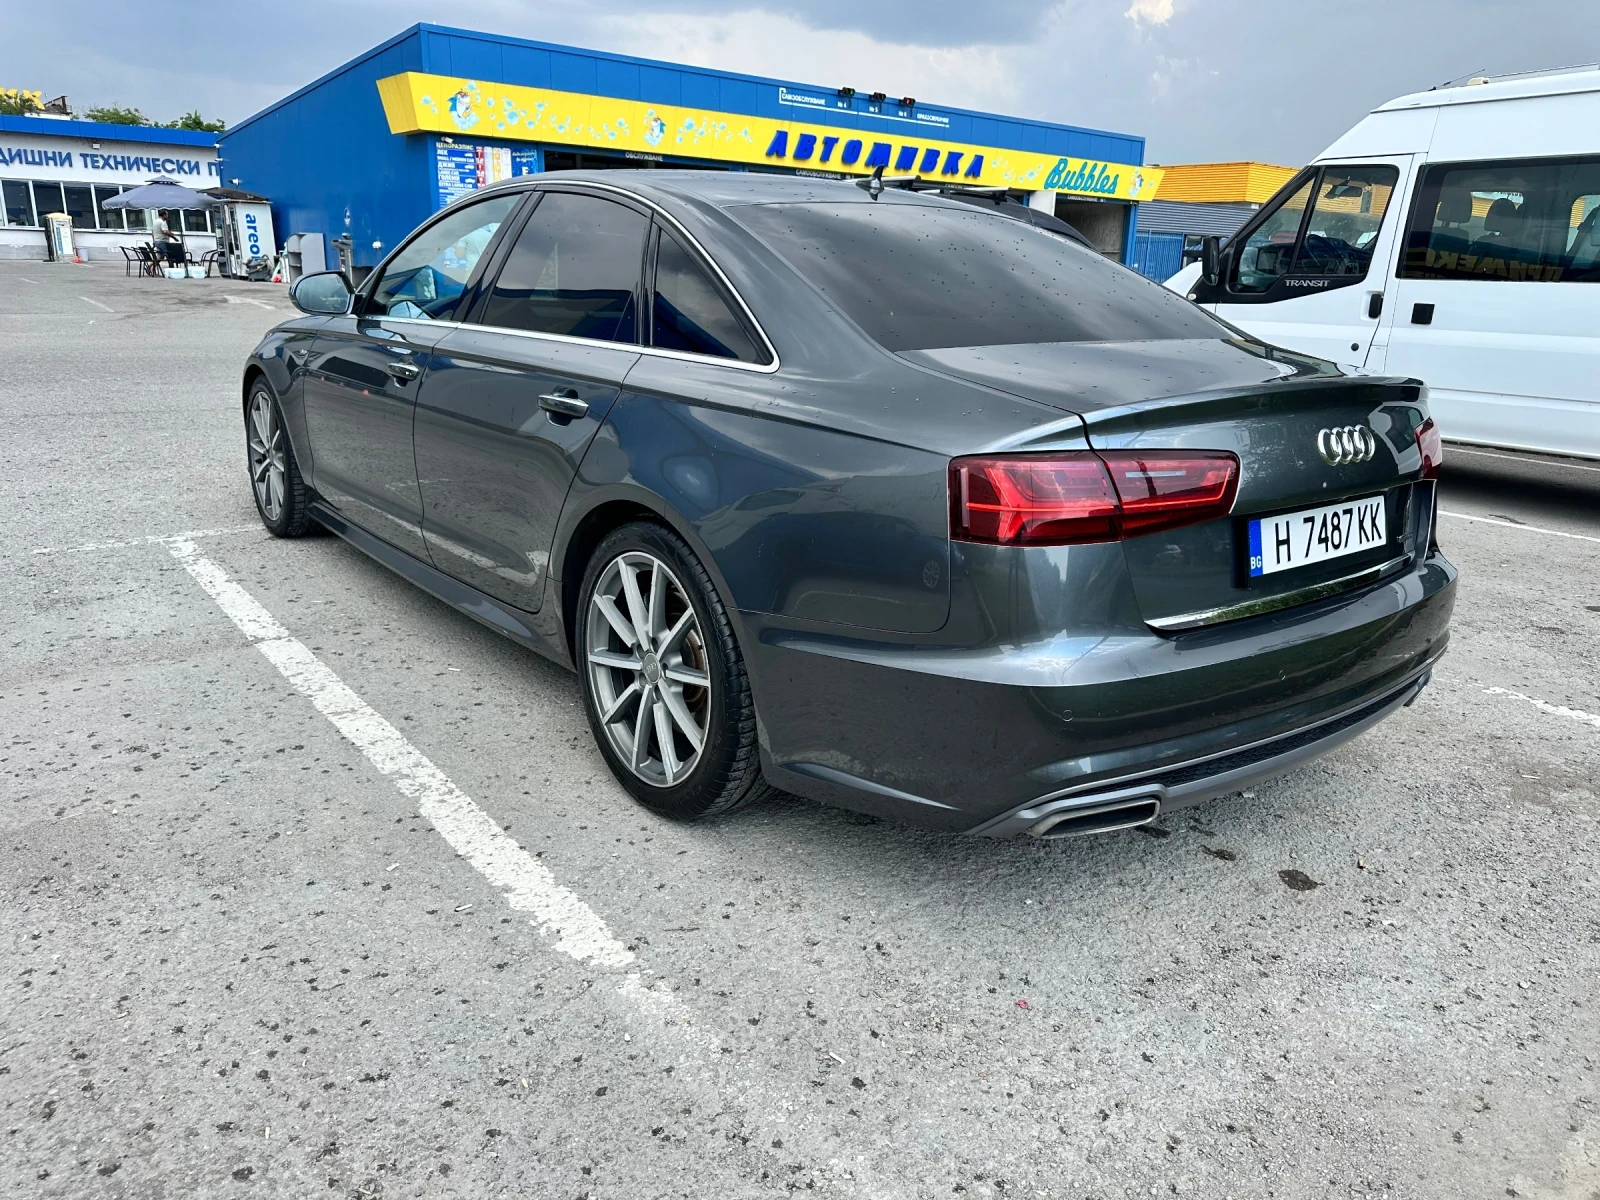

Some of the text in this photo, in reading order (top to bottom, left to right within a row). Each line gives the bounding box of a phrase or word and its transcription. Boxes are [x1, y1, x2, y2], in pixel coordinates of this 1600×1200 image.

[781, 93, 826, 105] САМООБСЛУЖВАНЕ
[80, 153, 201, 175] ТЕХНИЧЕСКИ
[765, 129, 985, 178] АВТОМИВКА
[1044, 158, 1119, 194] Bubbles
[1274, 520, 1292, 565] H
[1250, 555, 1262, 570] BG
